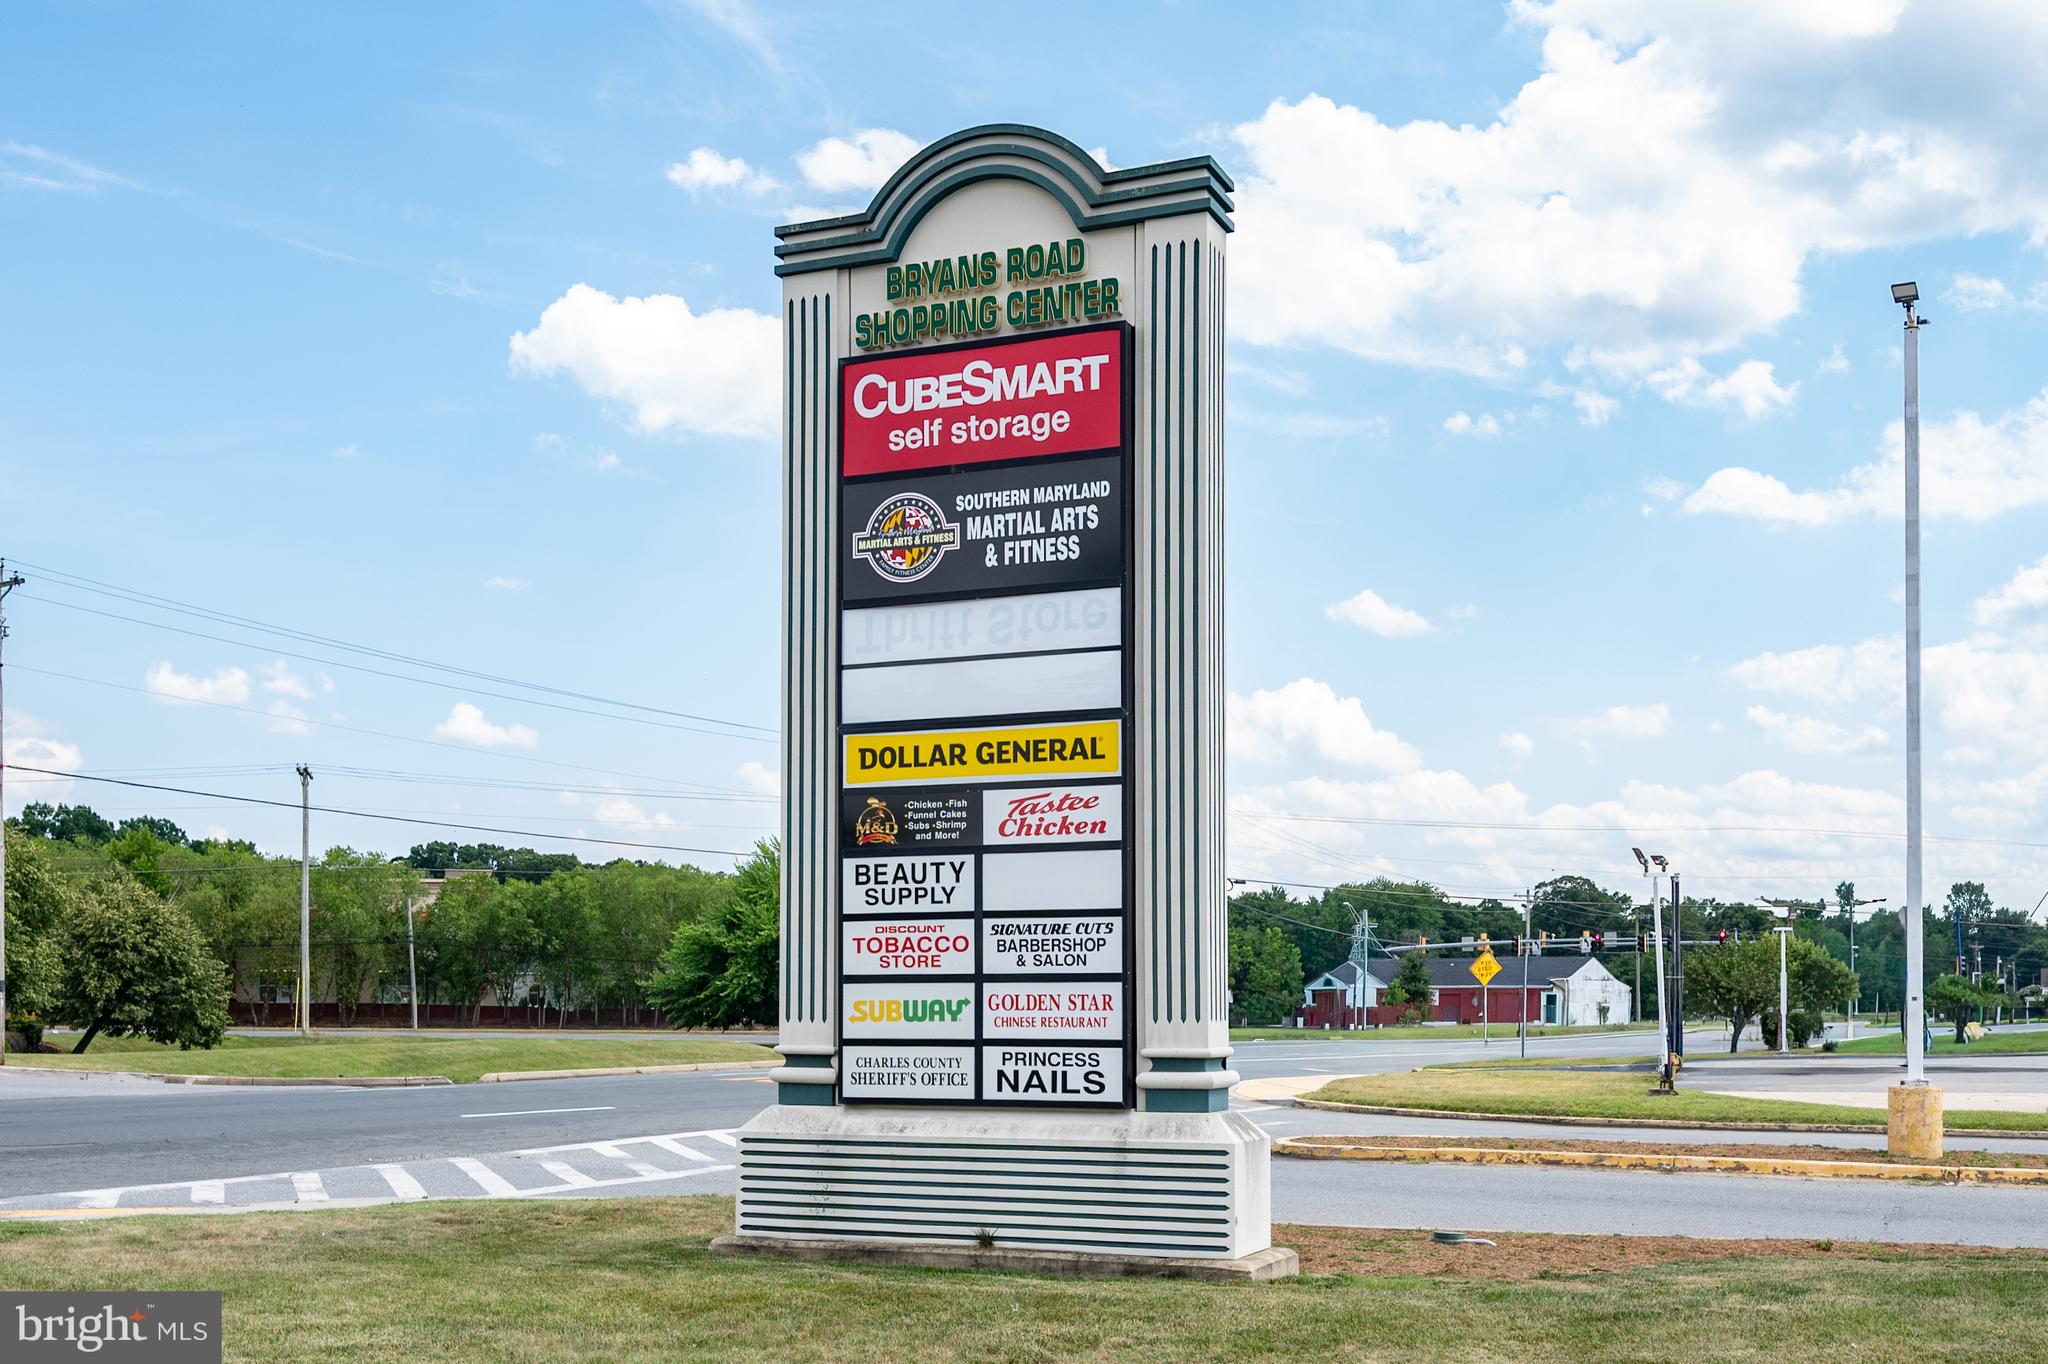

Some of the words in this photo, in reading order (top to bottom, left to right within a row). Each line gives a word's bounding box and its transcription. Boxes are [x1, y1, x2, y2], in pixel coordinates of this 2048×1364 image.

[887, 251, 998, 302] BRYANS
[1007, 238, 1086, 283] ROAD
[855, 295, 998, 349] SHOPPING
[1007, 277, 1120, 327] CENTER
[888, 418, 942, 451] self
[951, 410, 1070, 445] storage
[956, 488, 1029, 512] SOUTHERN
[1033, 480, 1111, 503] MARYLAND
[967, 510, 1045, 540] MARTIAL
[1051, 504, 1099, 531] ARTS
[859, 538, 892, 550] MARTIAL
[893, 536, 913, 546] ARTS
[914, 535, 920, 545] &
[922, 532, 954, 544] FITNESS
[985, 543, 998, 567] &
[1004, 535, 1080, 566] FITNESS
[878, 560, 895, 574] FAMILY
[916, 555, 935, 572] CENTER
[858, 743, 967, 770] DOLLAR
[976, 737, 1105, 765] GENERAL
[908, 811, 937, 819] Funnel
[940, 810, 967, 818] Cakes
[1007, 792, 1100, 818] Tastee
[856, 819, 898, 837] M&D
[915, 832, 931, 840] and
[935, 831, 960, 840] More!
[998, 816, 1107, 837] Chicken
[855, 861, 965, 886] BEAUTY
[864, 886, 956, 906] SUPPLY
[875, 925, 945, 934] DISCOUNT
[990, 923, 1073, 936] SIGNATURE
[1075, 922, 1114, 934] CUTS
[852, 935, 970, 954] TOBACCO
[997, 938, 1107, 953] BARBERSHOP
[879, 954, 942, 969] STORE
[1016, 955, 1026, 967] &
[1033, 954, 1087, 967] SALON
[848, 997, 972, 1023] SUBWAY
[988, 994, 1060, 1012] GOLDEN
[1068, 993, 1114, 1012] STAR
[994, 1017, 1037, 1028] CHINESE
[1040, 1017, 1108, 1028] RESTAURANT
[856, 1057, 910, 1069] CHARLES
[913, 1057, 963, 1069] COUNTY
[1002, 1052, 1100, 1067] PRINCESS
[850, 1071, 917, 1086] SHERIFF'S
[921, 1072, 968, 1086] OFFICE
[997, 1069, 1106, 1095] NAILS
